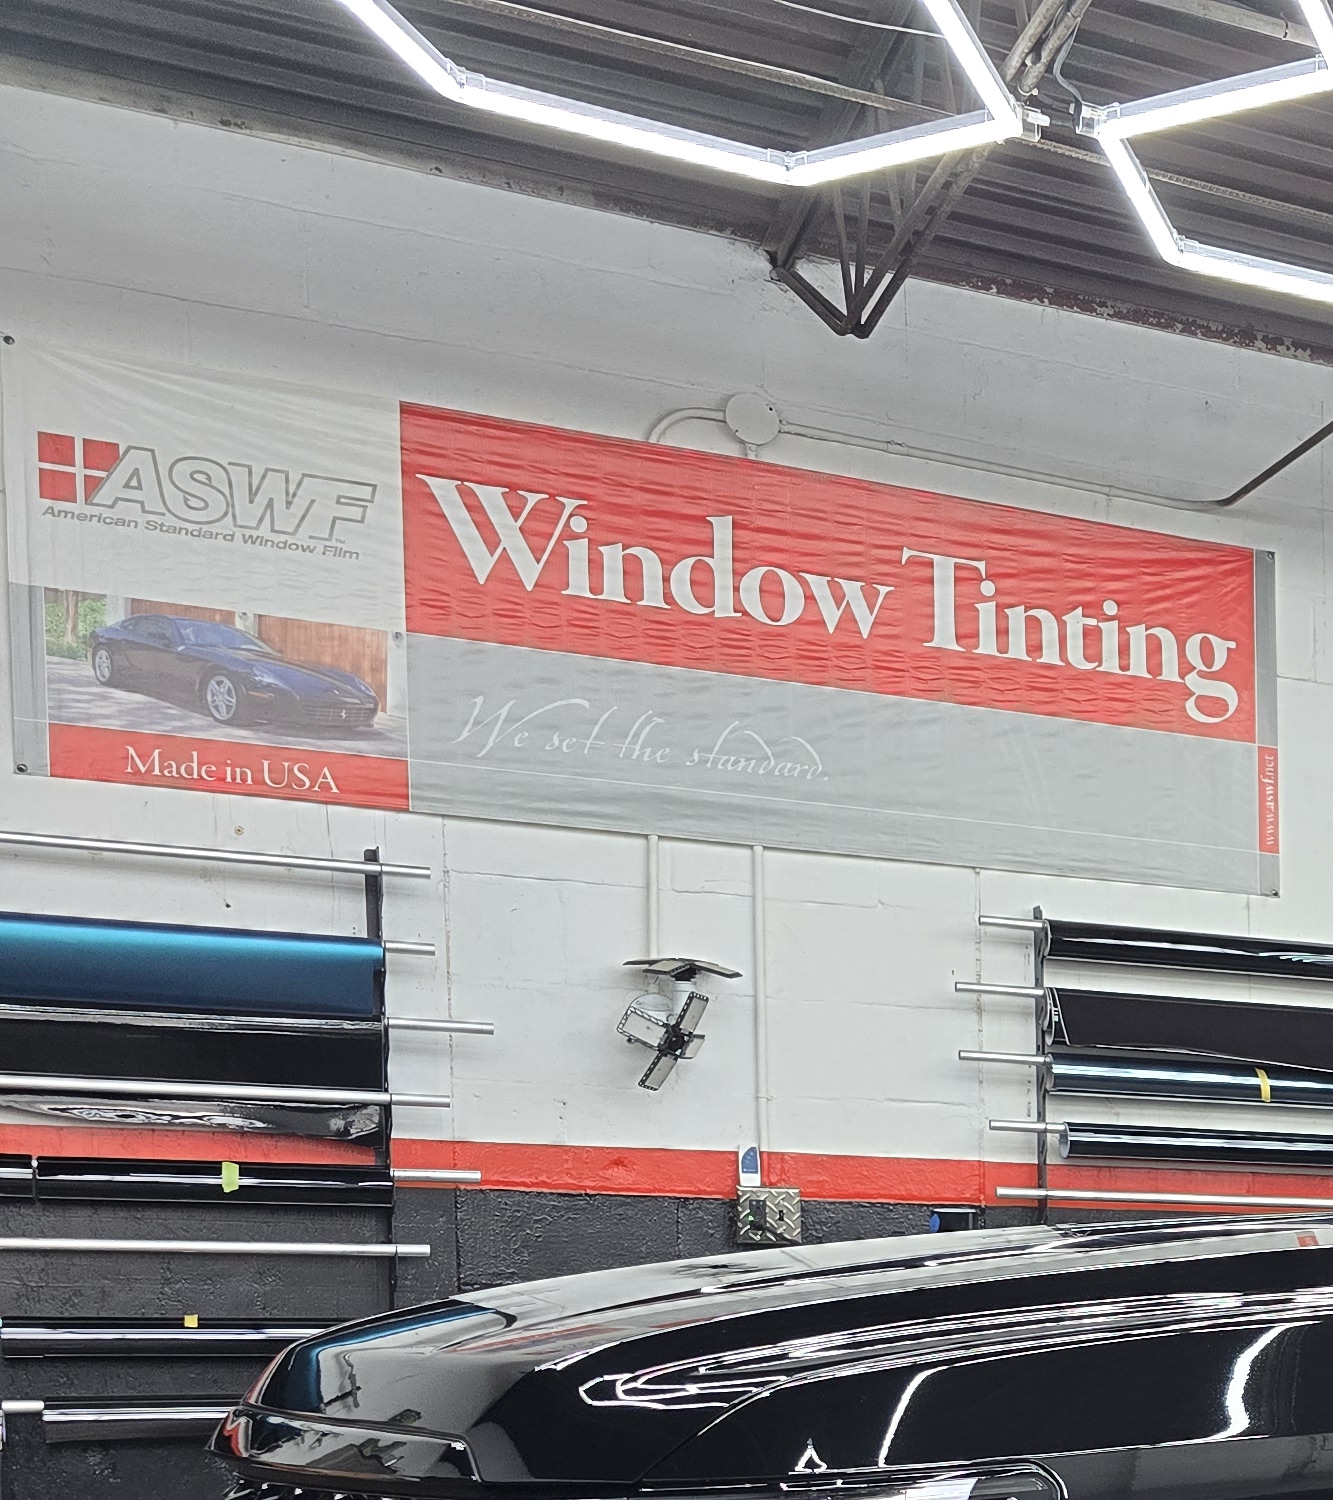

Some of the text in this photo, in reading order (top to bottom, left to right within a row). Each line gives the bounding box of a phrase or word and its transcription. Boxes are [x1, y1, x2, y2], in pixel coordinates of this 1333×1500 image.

[41, 505, 360, 561] American Standard Window Film
[84, 445, 378, 541] ASWF
[415, 472, 1239, 724] Window Tinting
[124, 745, 341, 794] Made in USA
[450, 695, 590, 758] We
[544, 706, 618, 755] set
[613, 710, 672, 764] the
[1260, 754, 1275, 846] www.aswf.net
